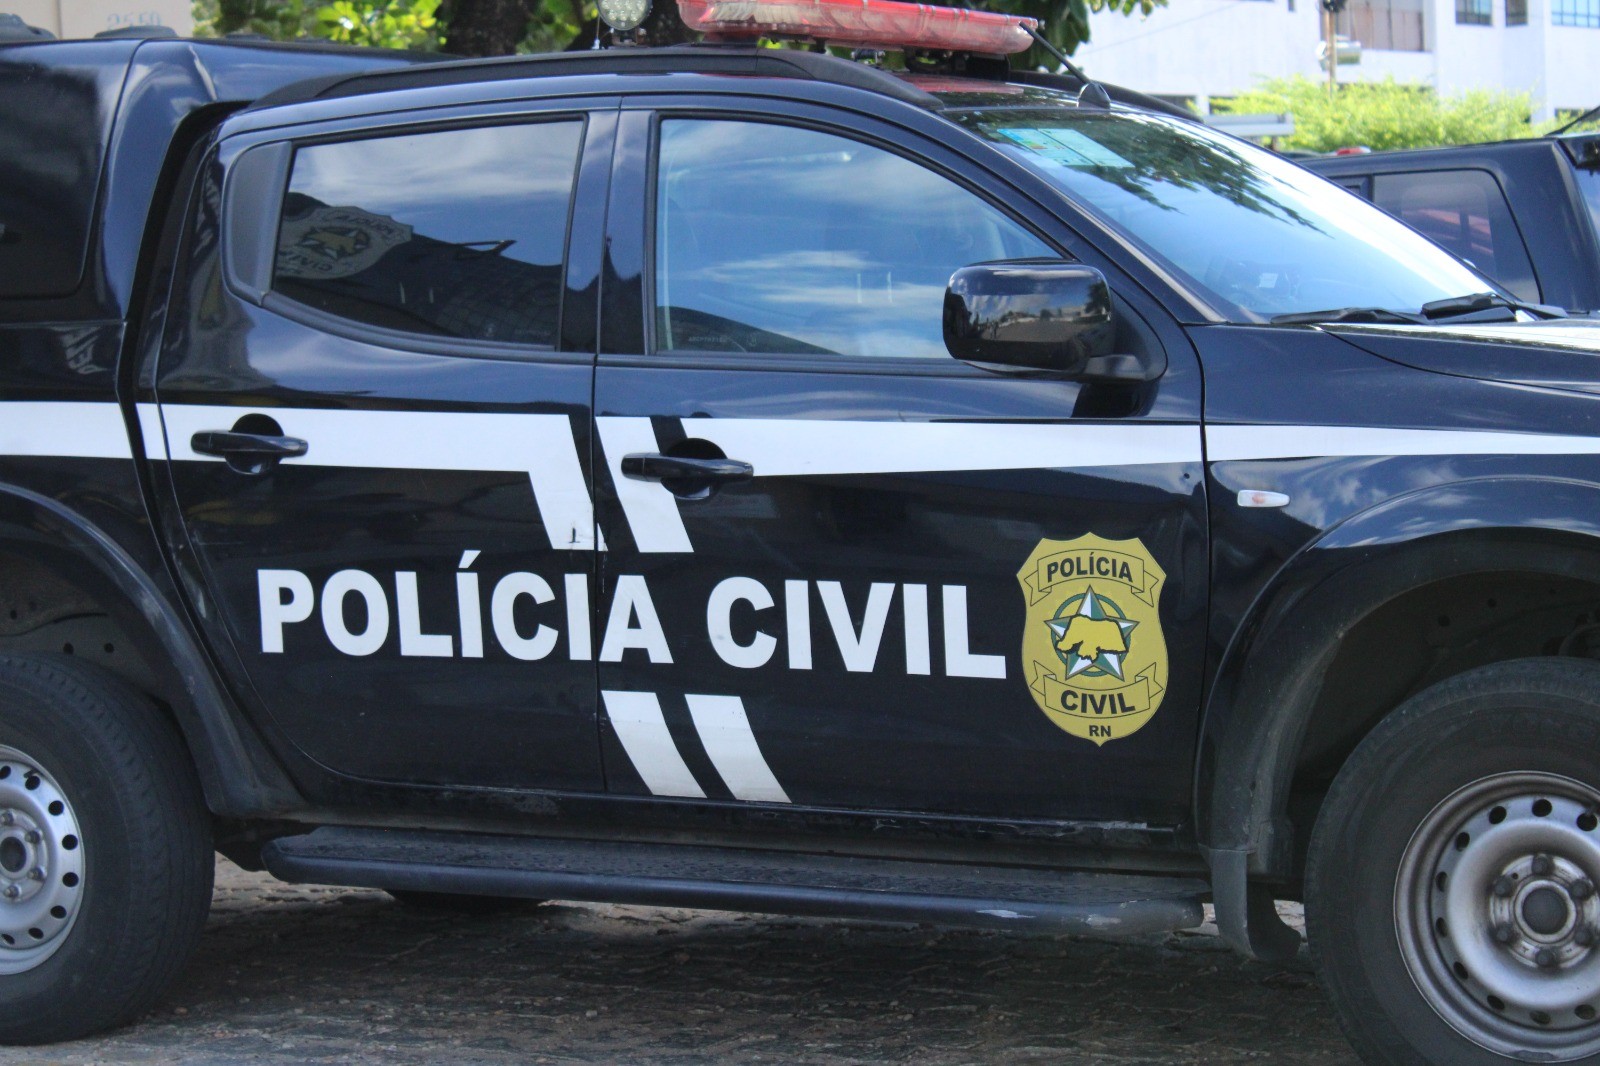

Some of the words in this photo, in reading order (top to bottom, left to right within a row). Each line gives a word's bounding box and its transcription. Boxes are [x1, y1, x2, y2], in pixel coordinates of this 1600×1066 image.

[1047, 552, 1133, 583] POLÍCIA
[257, 549, 674, 664] POLÍCIA
[707, 576, 1006, 679] CIVIL
[1060, 689, 1136, 715] CIVIL
[1089, 724, 1112, 737] RN
